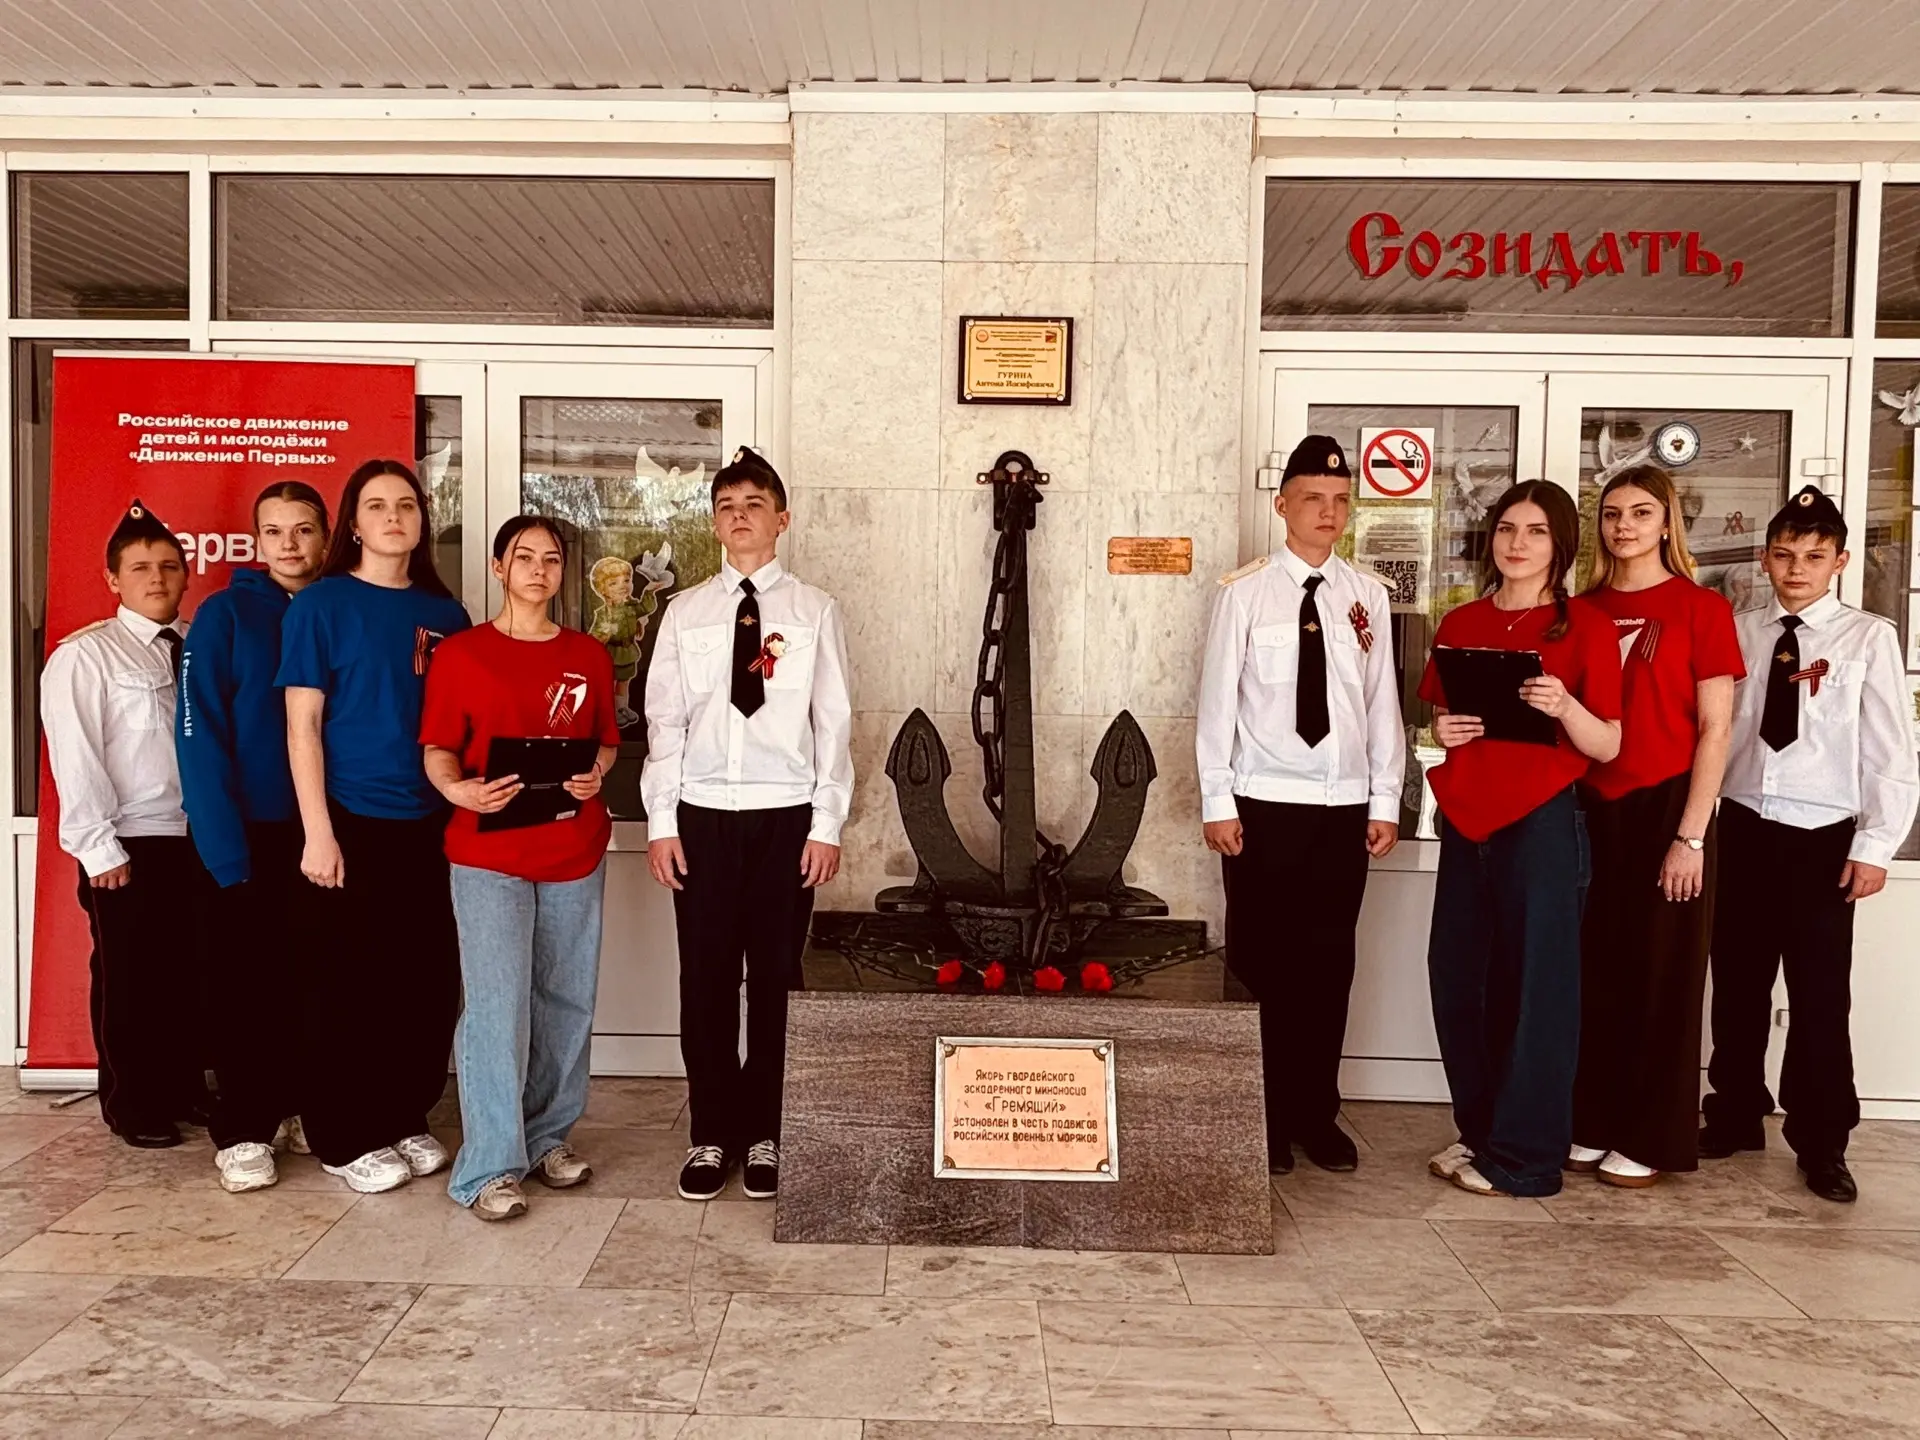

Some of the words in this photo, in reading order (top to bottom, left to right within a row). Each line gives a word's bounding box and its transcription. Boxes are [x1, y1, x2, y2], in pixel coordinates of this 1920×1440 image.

[1349, 211, 1744, 290] Созидать,
[997, 371, 1032, 379] ГУРИНА
[118, 413, 241, 428] Российское
[244, 418, 349, 431] движение
[139, 431, 200, 446] детей
[203, 434, 217, 445] и
[221, 433, 327, 448] молодёжи
[129, 447, 244, 463] «Движение
[248, 449, 336, 466] Первых»
[162, 523, 266, 575] ерв
[975, 1069, 1004, 1081] Якорь
[1007, 1070, 1075, 1082] гвардейского
[964, 1085, 1032, 1095] эскадренного
[1035, 1086, 1087, 1096] миноносца
[985, 1096, 1067, 1113] «Гремящий»
[1012, 1118, 1018, 1128] в
[1021, 1118, 1049, 1129] честь
[1052, 1118, 1098, 1130] подвигов
[1012, 1132, 1055, 1142] военных
[1057, 1133, 1098, 1143] моряков
